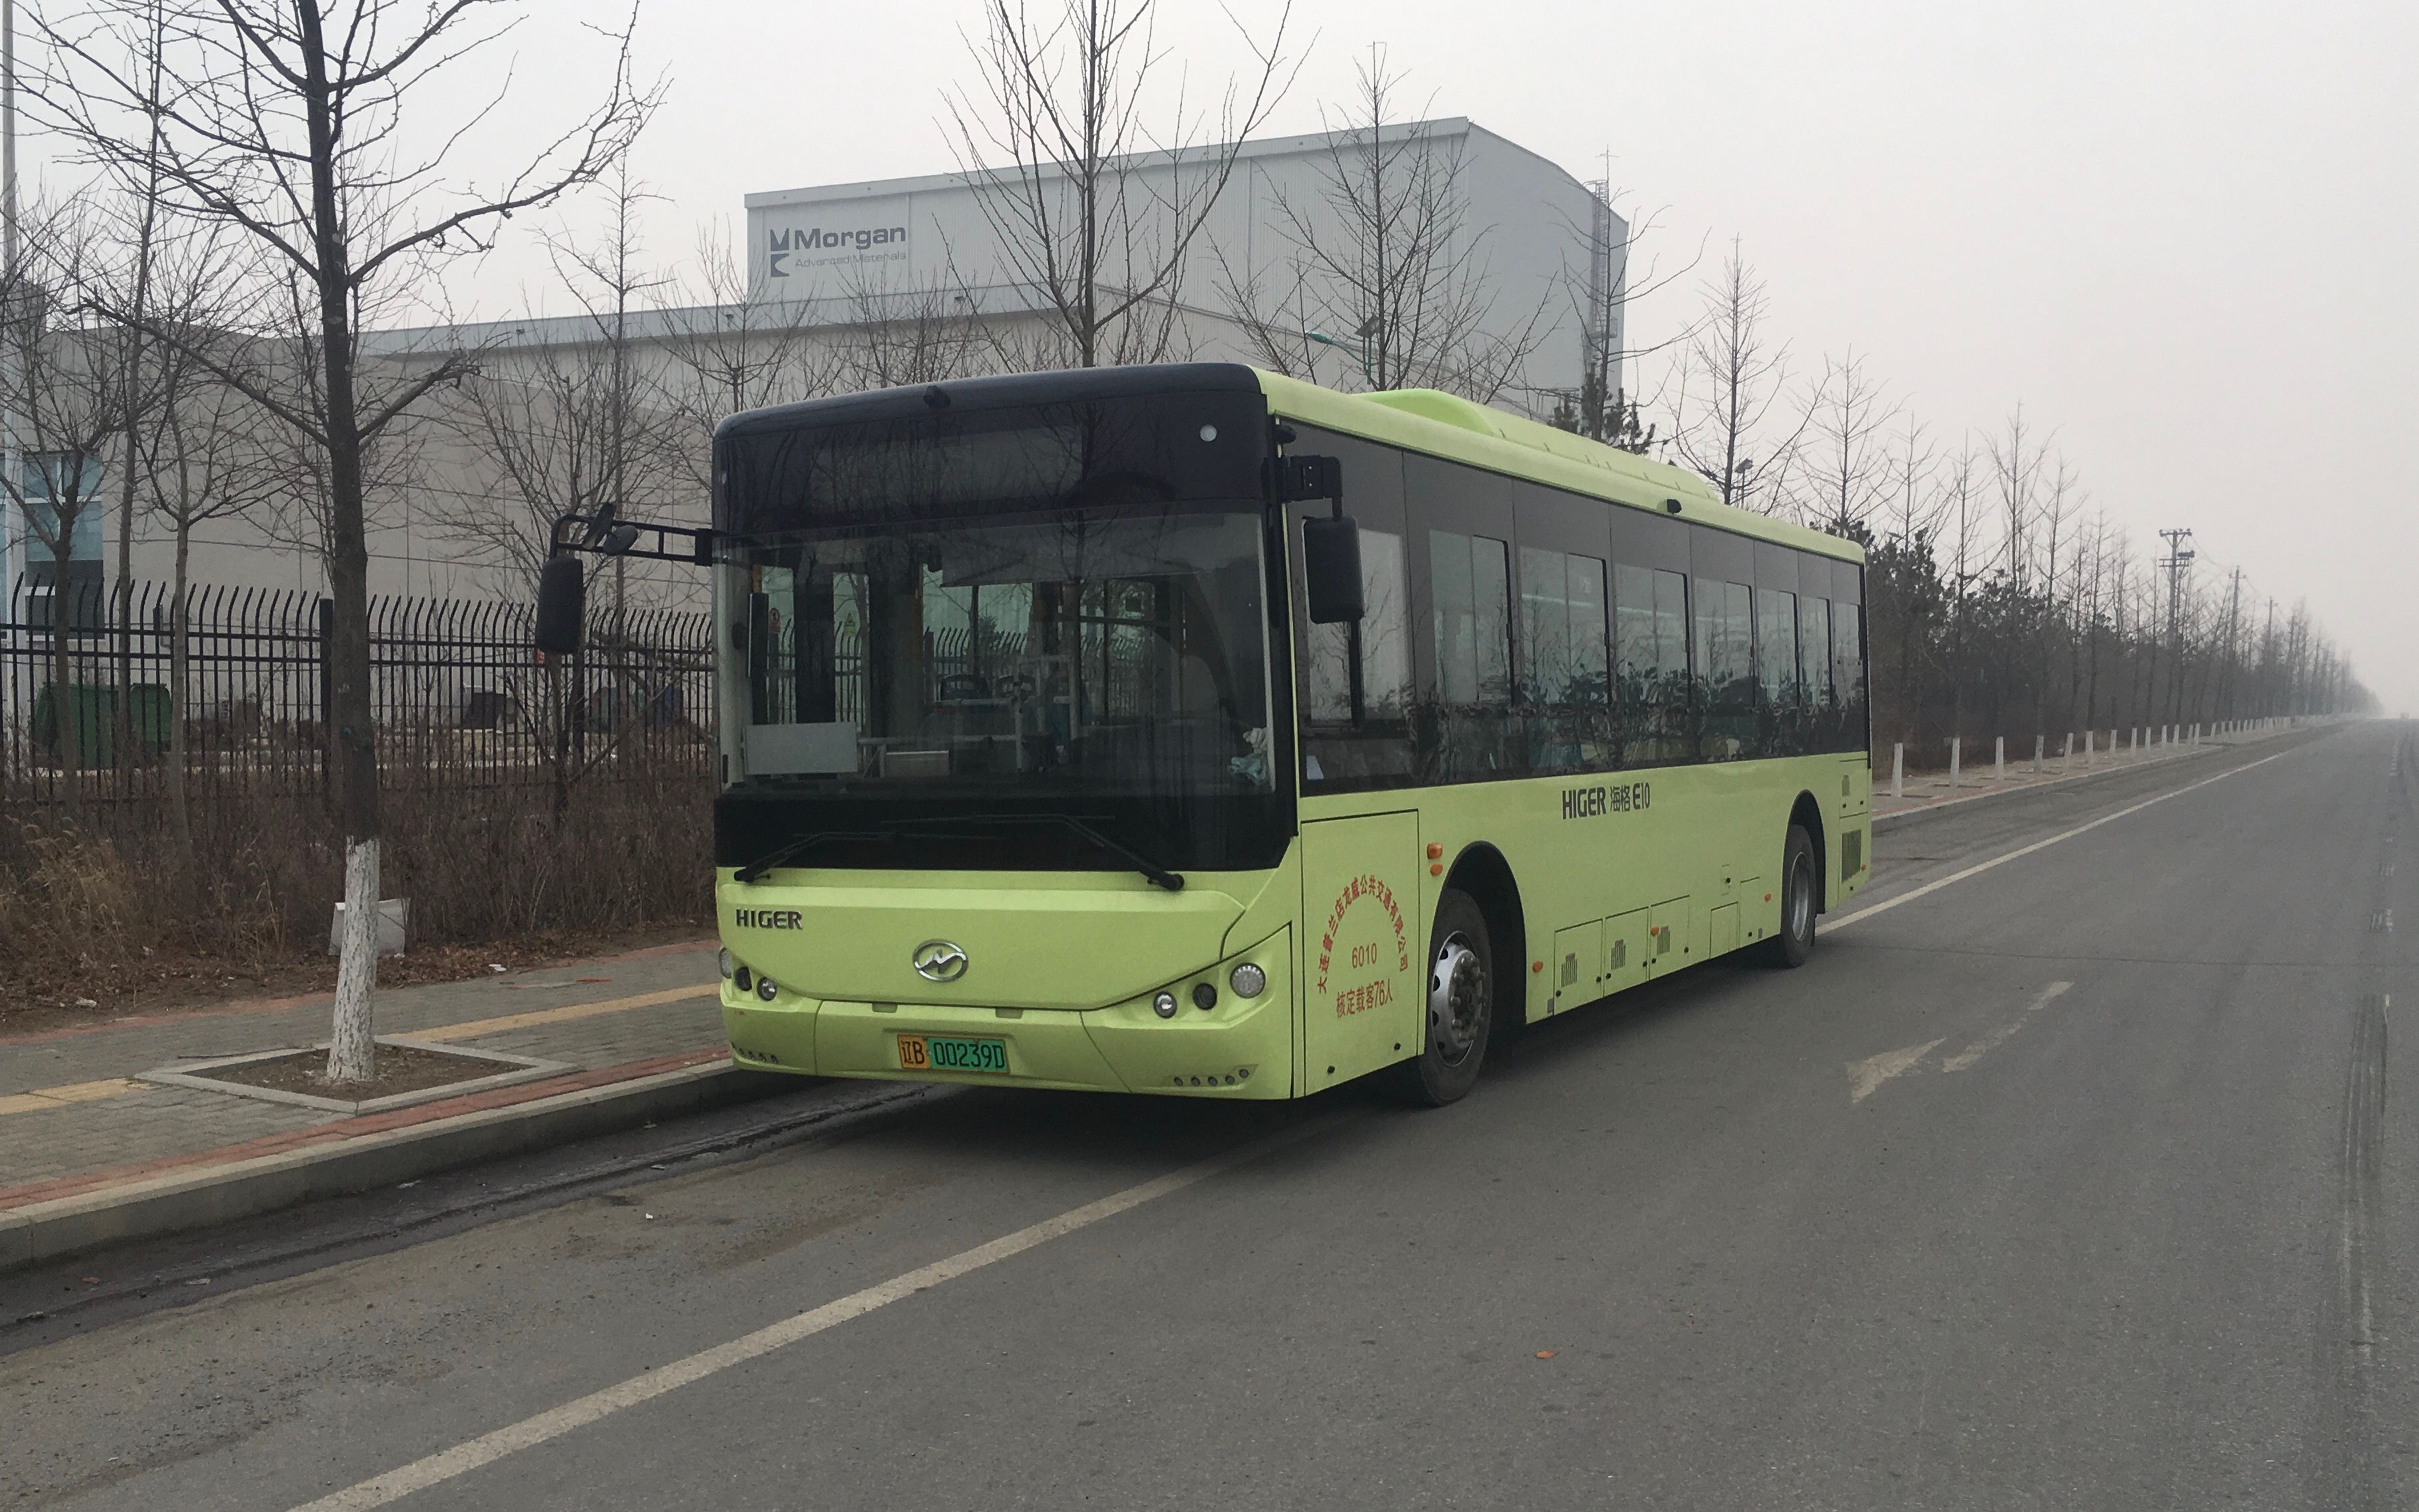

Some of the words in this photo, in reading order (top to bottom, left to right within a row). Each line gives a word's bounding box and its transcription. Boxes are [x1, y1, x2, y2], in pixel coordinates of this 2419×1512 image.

[794, 227, 906, 250] Morgan
[795, 255, 850, 267] Advanced
[852, 251, 907, 265] Materials
[1562, 787, 1606, 819] HIGER
[1610, 785, 1630, 812] 海格
[1632, 782, 1650, 809] E10
[736, 909, 803, 930] HIGER
[1352, 943, 1377, 969] 6010
[1336, 978, 1393, 1019] 核定载客76人
[933, 1043, 1005, 1069] 00239D
